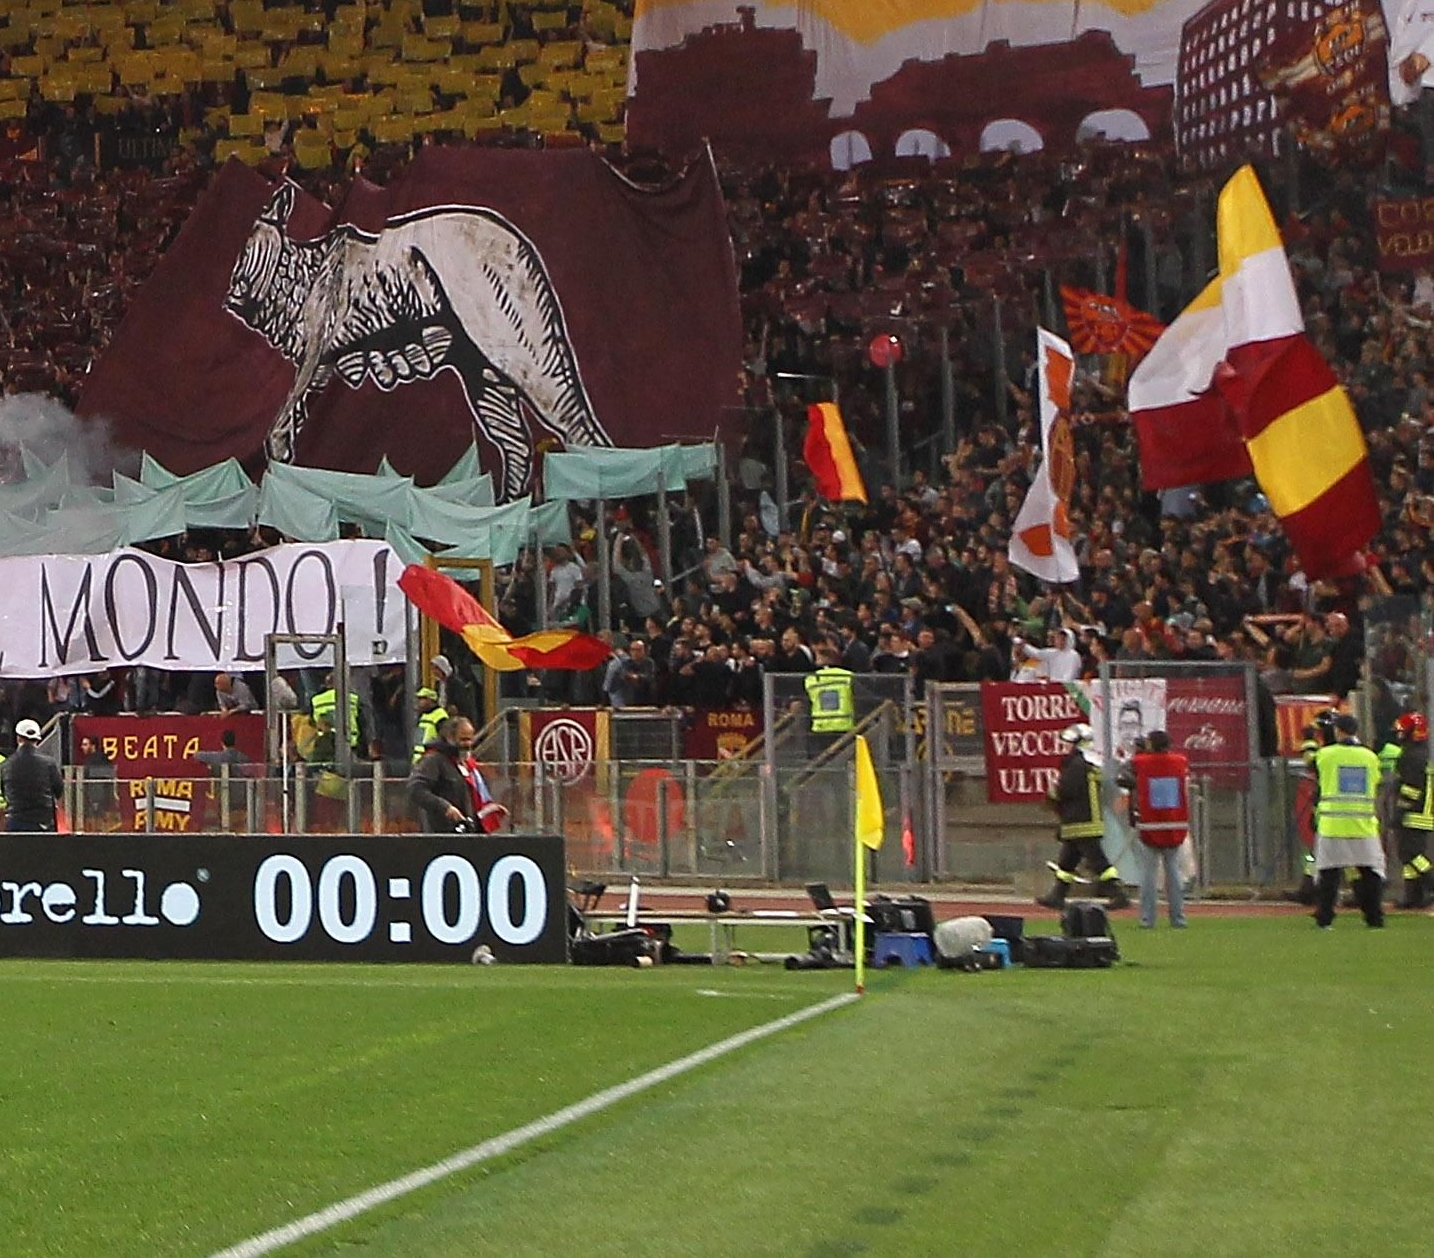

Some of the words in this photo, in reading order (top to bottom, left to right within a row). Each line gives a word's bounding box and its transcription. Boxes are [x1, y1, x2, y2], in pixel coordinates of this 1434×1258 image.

[707, 710, 755, 728] ROMA
[1001, 693, 1081, 722] TORRE
[102, 734, 200, 761] BEATA
[254, 854, 547, 945] 00:00
